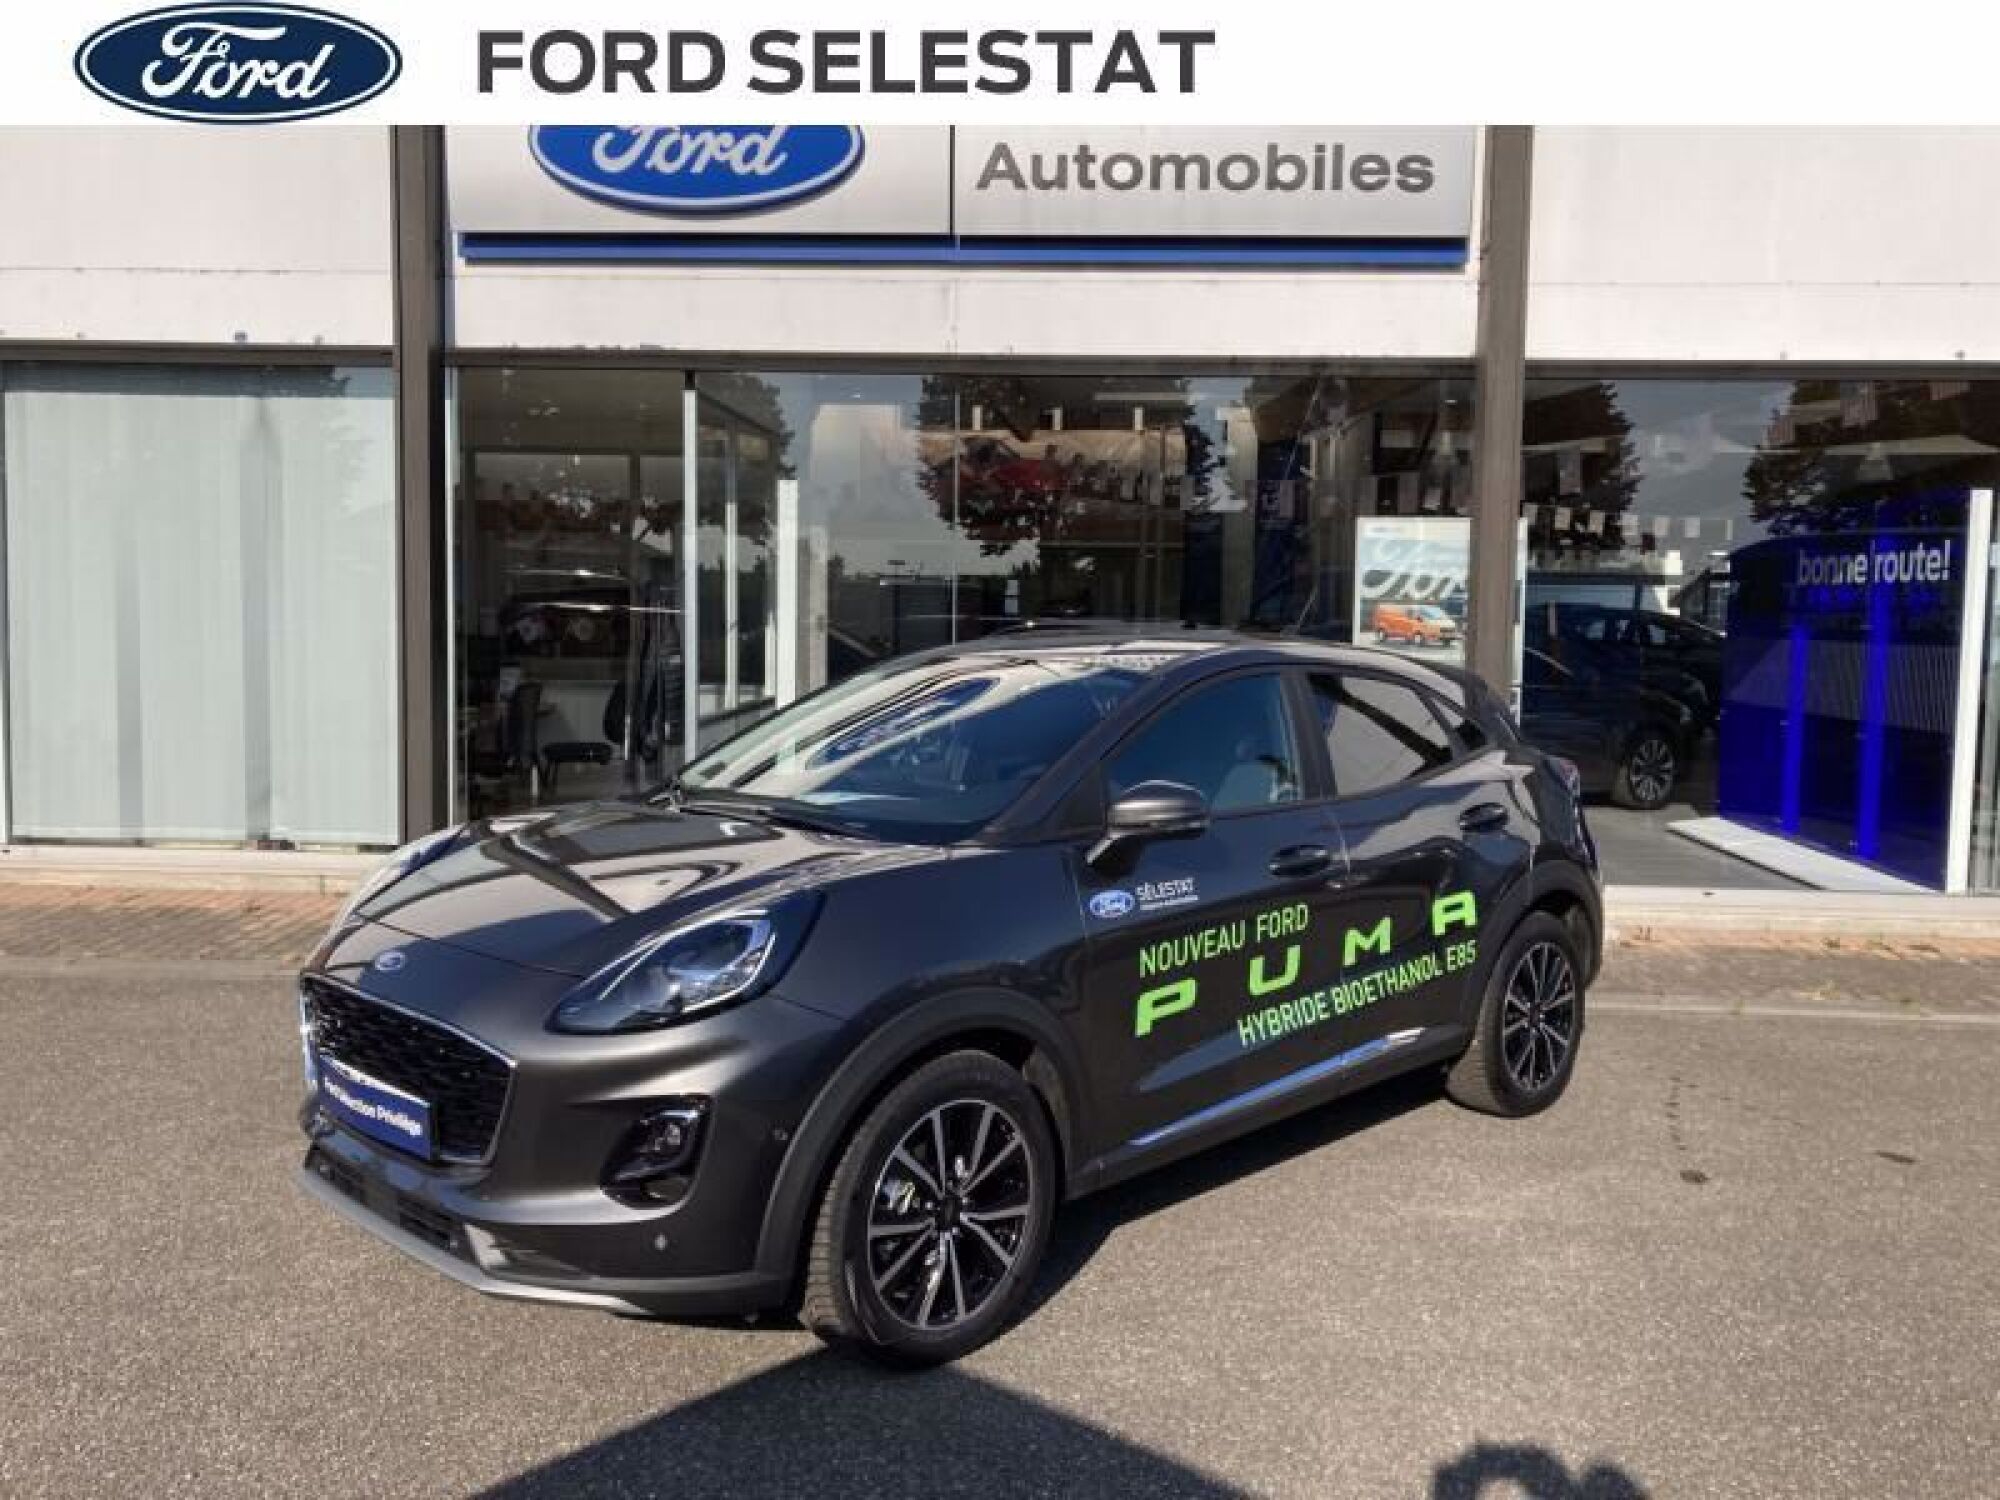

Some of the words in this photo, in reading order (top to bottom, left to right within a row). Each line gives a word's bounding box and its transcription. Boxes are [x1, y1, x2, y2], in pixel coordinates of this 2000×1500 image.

[975, 141, 1436, 194] Automobiles
[1798, 550, 1868, 586] bonne
[1873, 539, 1951, 584] route!
[1134, 890, 1479, 1037] PUMA
[1139, 919, 1246, 978] NOUVEAU
[1255, 903, 1310, 944] FORD
[1237, 991, 1333, 1047] HYBRIDE
[1332, 951, 1444, 1014] BIOETHANOL
[1446, 939, 1478, 972] E85
